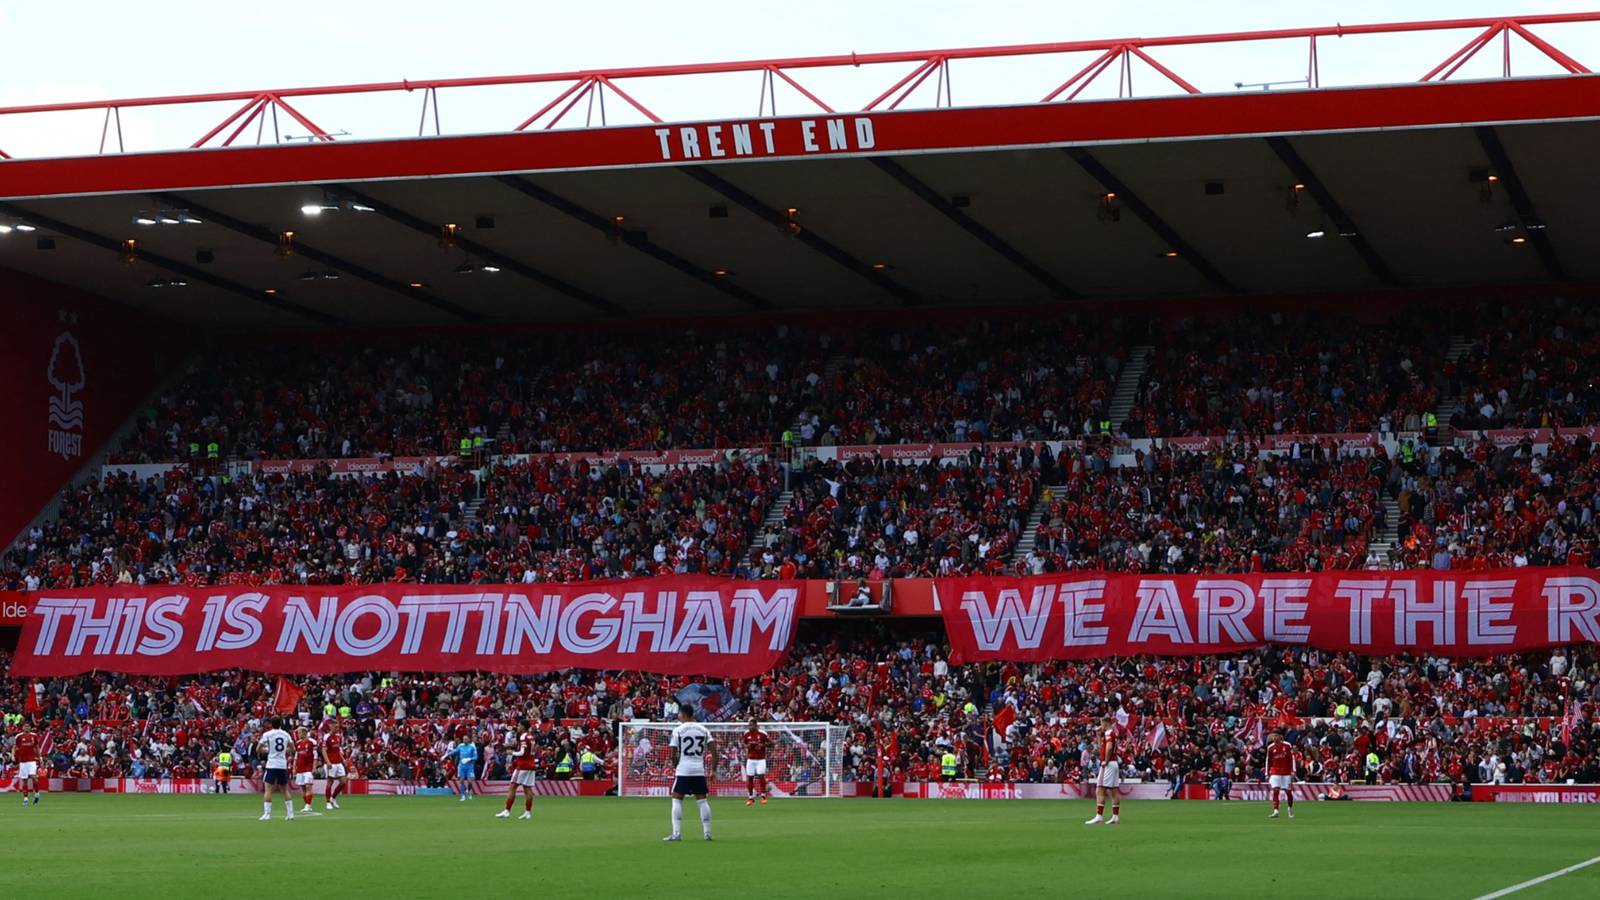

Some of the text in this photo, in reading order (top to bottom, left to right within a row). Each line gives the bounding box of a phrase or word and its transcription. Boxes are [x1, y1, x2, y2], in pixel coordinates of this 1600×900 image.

[655, 118, 875, 159] TRENT END
[680, 453, 713, 464] Ideagen
[893, 448, 927, 459] Ideagen
[33, 588, 798, 656] THIS IS NOTTINGHAM
[960, 576, 1600, 651] WE ARE THE R
[275, 737, 285, 752] 8
[683, 736, 705, 756] 23
